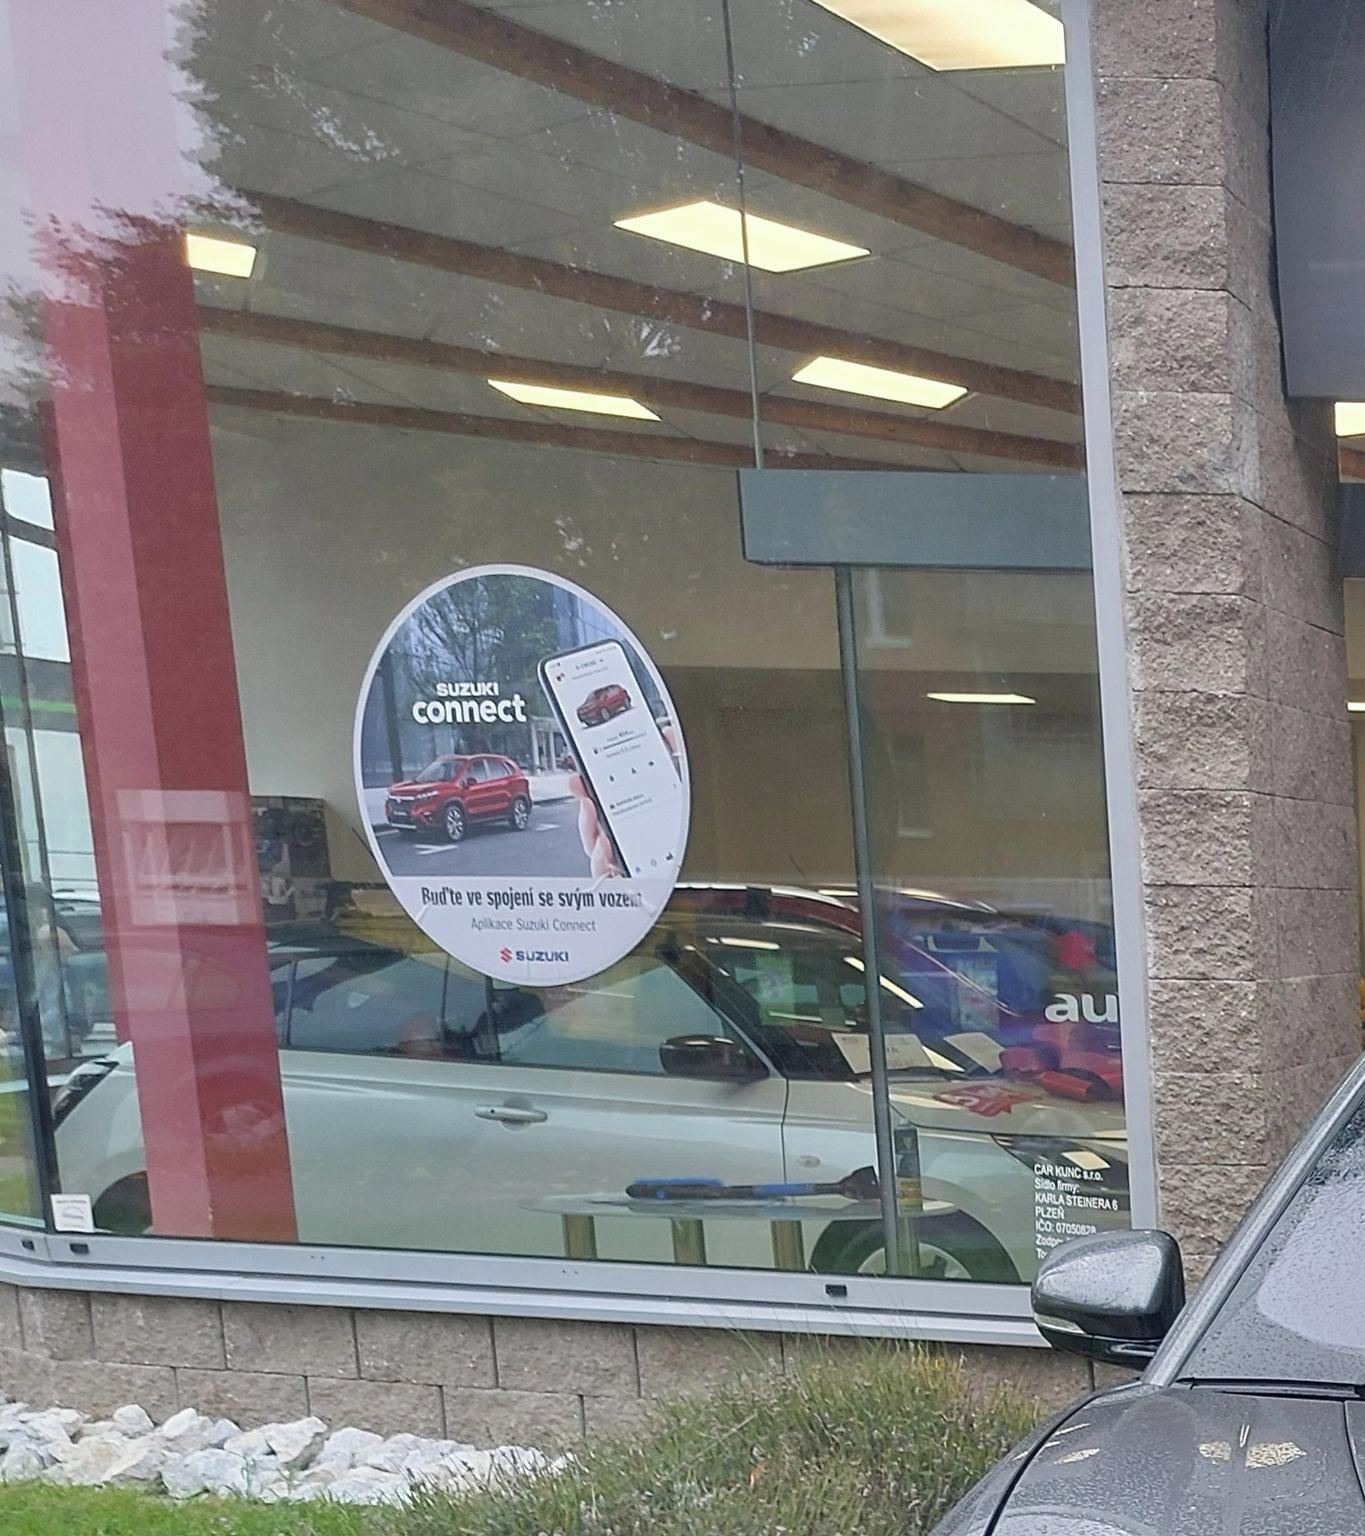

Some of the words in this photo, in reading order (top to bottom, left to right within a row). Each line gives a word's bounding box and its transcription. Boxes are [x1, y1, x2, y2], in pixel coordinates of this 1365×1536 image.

[436, 681, 499, 697] SUZUKI
[412, 693, 527, 724] connect
[467, 890, 482, 906] ve
[487, 886, 534, 910] spojení
[539, 891, 553, 906] se
[558, 887, 594, 911] svým
[471, 917, 512, 931] Aplikace
[518, 917, 548, 931] Suzuki
[553, 918, 596, 932] Connect
[515, 950, 569, 962] SUZUKI
[1034, 1163, 1054, 1177] CAR
[1055, 1165, 1082, 1179] KUNC
[1083, 1170, 1104, 1181] s.r.o.
[1035, 1192, 1065, 1206] KARLA
[1066, 1194, 1111, 1210] STEINERA
[1112, 1199, 1119, 1211] 6
[1035, 1205, 1065, 1220] PLZEŇ
[1035, 1218, 1054, 1232] IČO:
